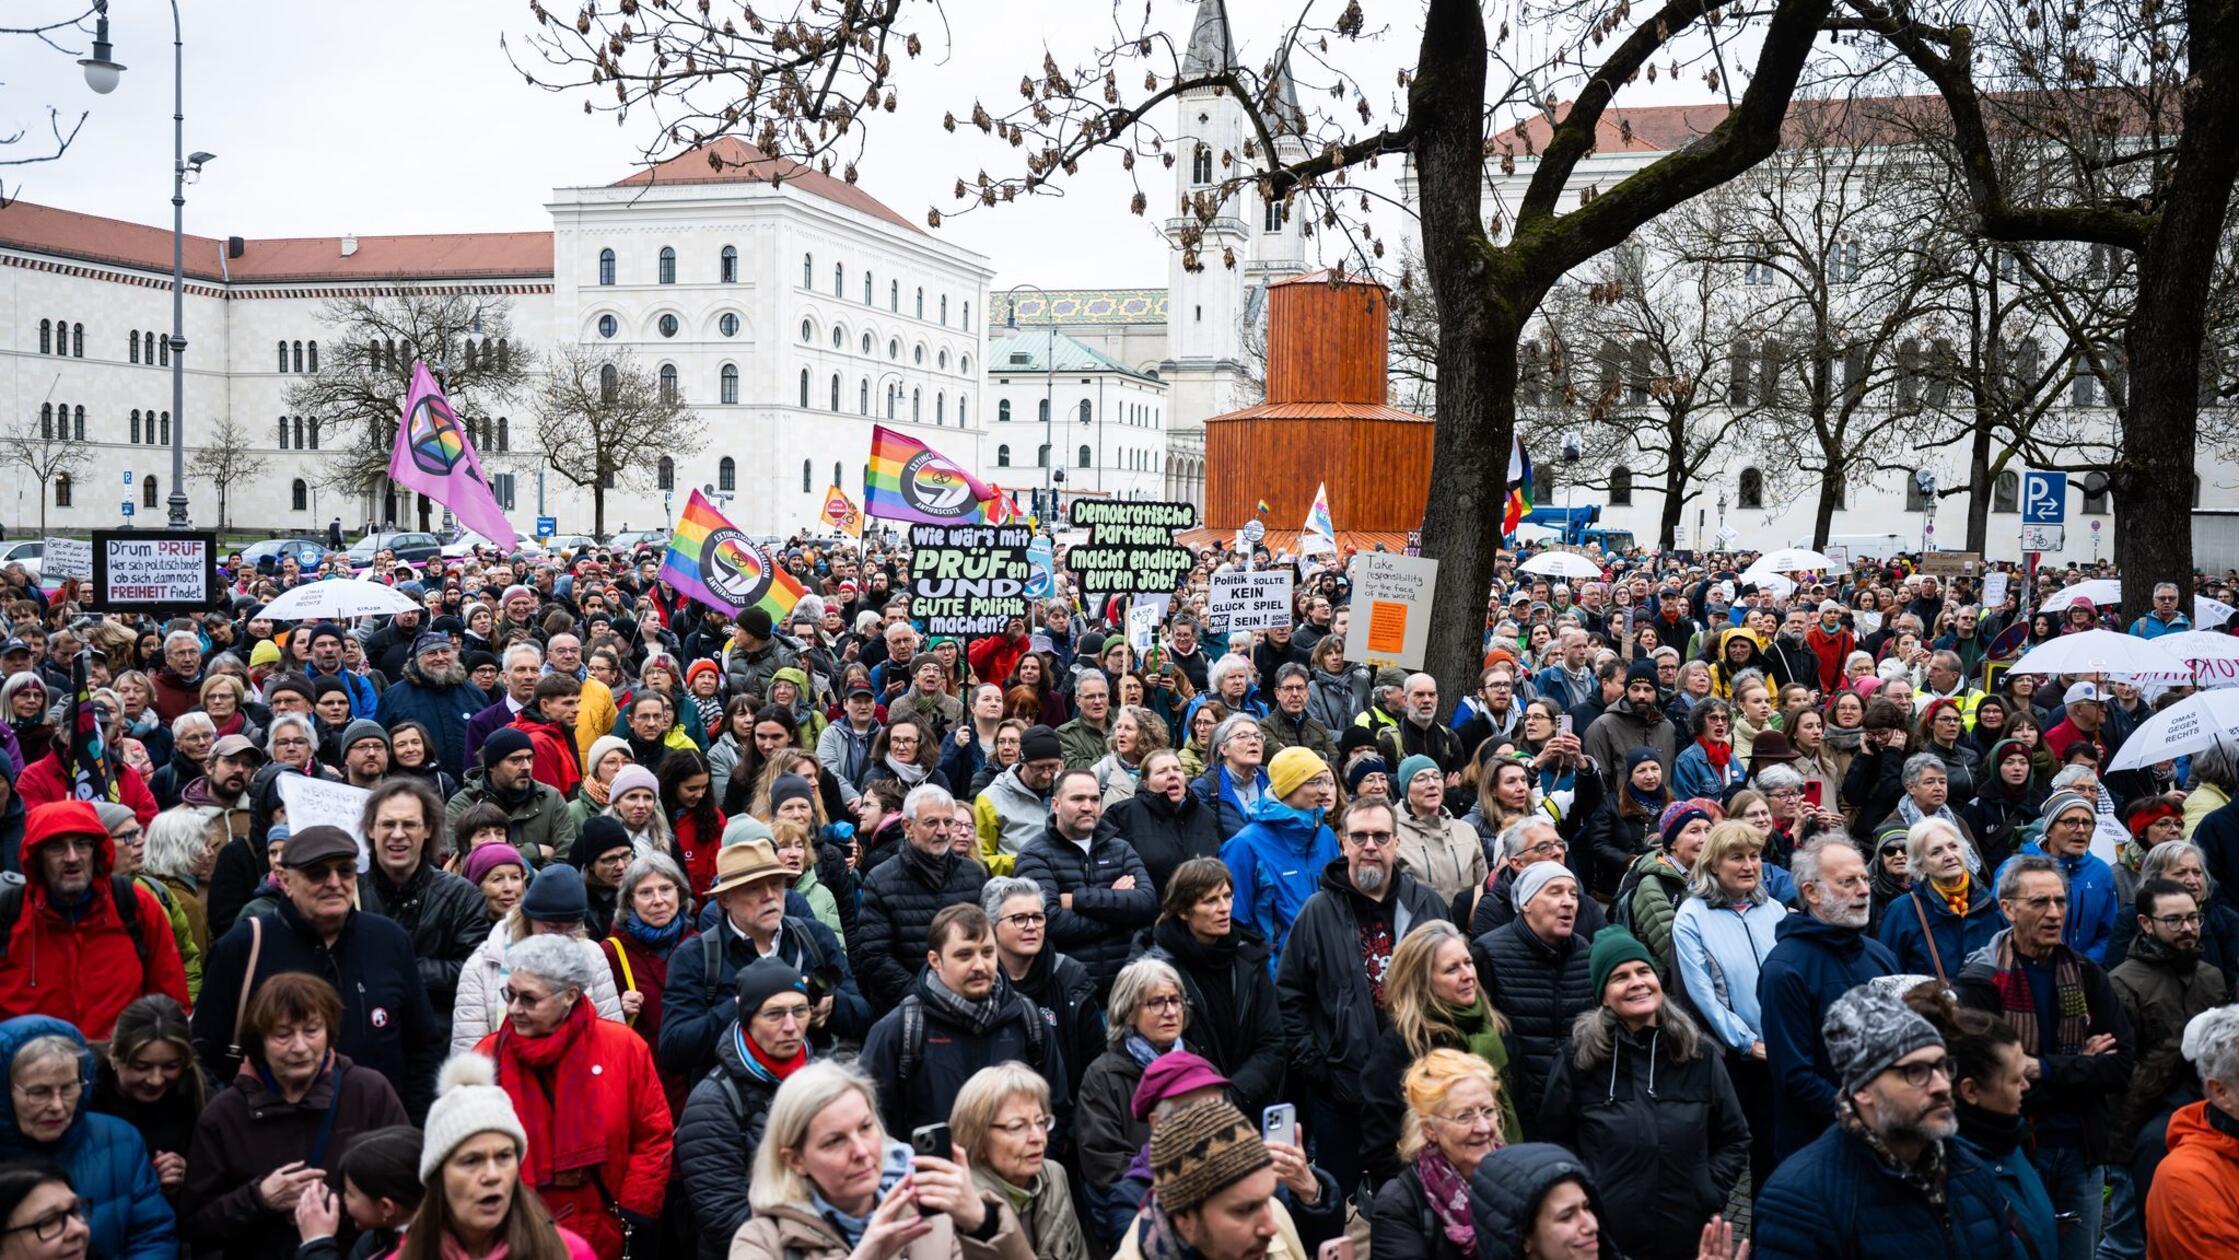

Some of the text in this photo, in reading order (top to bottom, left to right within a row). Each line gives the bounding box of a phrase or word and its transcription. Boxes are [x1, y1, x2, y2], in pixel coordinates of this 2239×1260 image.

[2028, 477, 2048, 515] P
[915, 502, 960, 515] ANTIFASCISTE
[1075, 502, 1192, 526] Demokratische
[714, 531, 752, 545] EXTINCTION
[913, 527, 1030, 547] Wie wär's mit
[1094, 524, 1170, 546] Parteien,
[158, 542, 202, 556] PRÜF
[110, 557, 203, 572] Wer sich politisch bindet
[912, 547, 1028, 579] PRÜFen
[1071, 550, 1192, 570] macht endlich
[1366, 554, 1394, 570] Take
[114, 572, 198, 584] ob sich dann noch
[1085, 570, 1178, 590] euren Job!
[1214, 576, 1284, 586] Politik SOLLTE
[1366, 581, 1378, 590] for
[1367, 572, 1423, 587] responsibility
[111, 585, 202, 598] FREIHEIT findet
[706, 576, 746, 604] ANTIFASCISTE
[917, 578, 1022, 598] UND
[1231, 587, 1264, 599] KEIN
[912, 598, 1025, 616] GUTE Politik
[1212, 600, 1284, 612] GLÜCK SPIEL
[930, 615, 1009, 634] machen?
[1234, 616, 1260, 626] SEIN
[2168, 718, 2198, 734] GEGEN
[2172, 712, 2196, 724] OMAS
[2166, 726, 2200, 744] RECHTS
